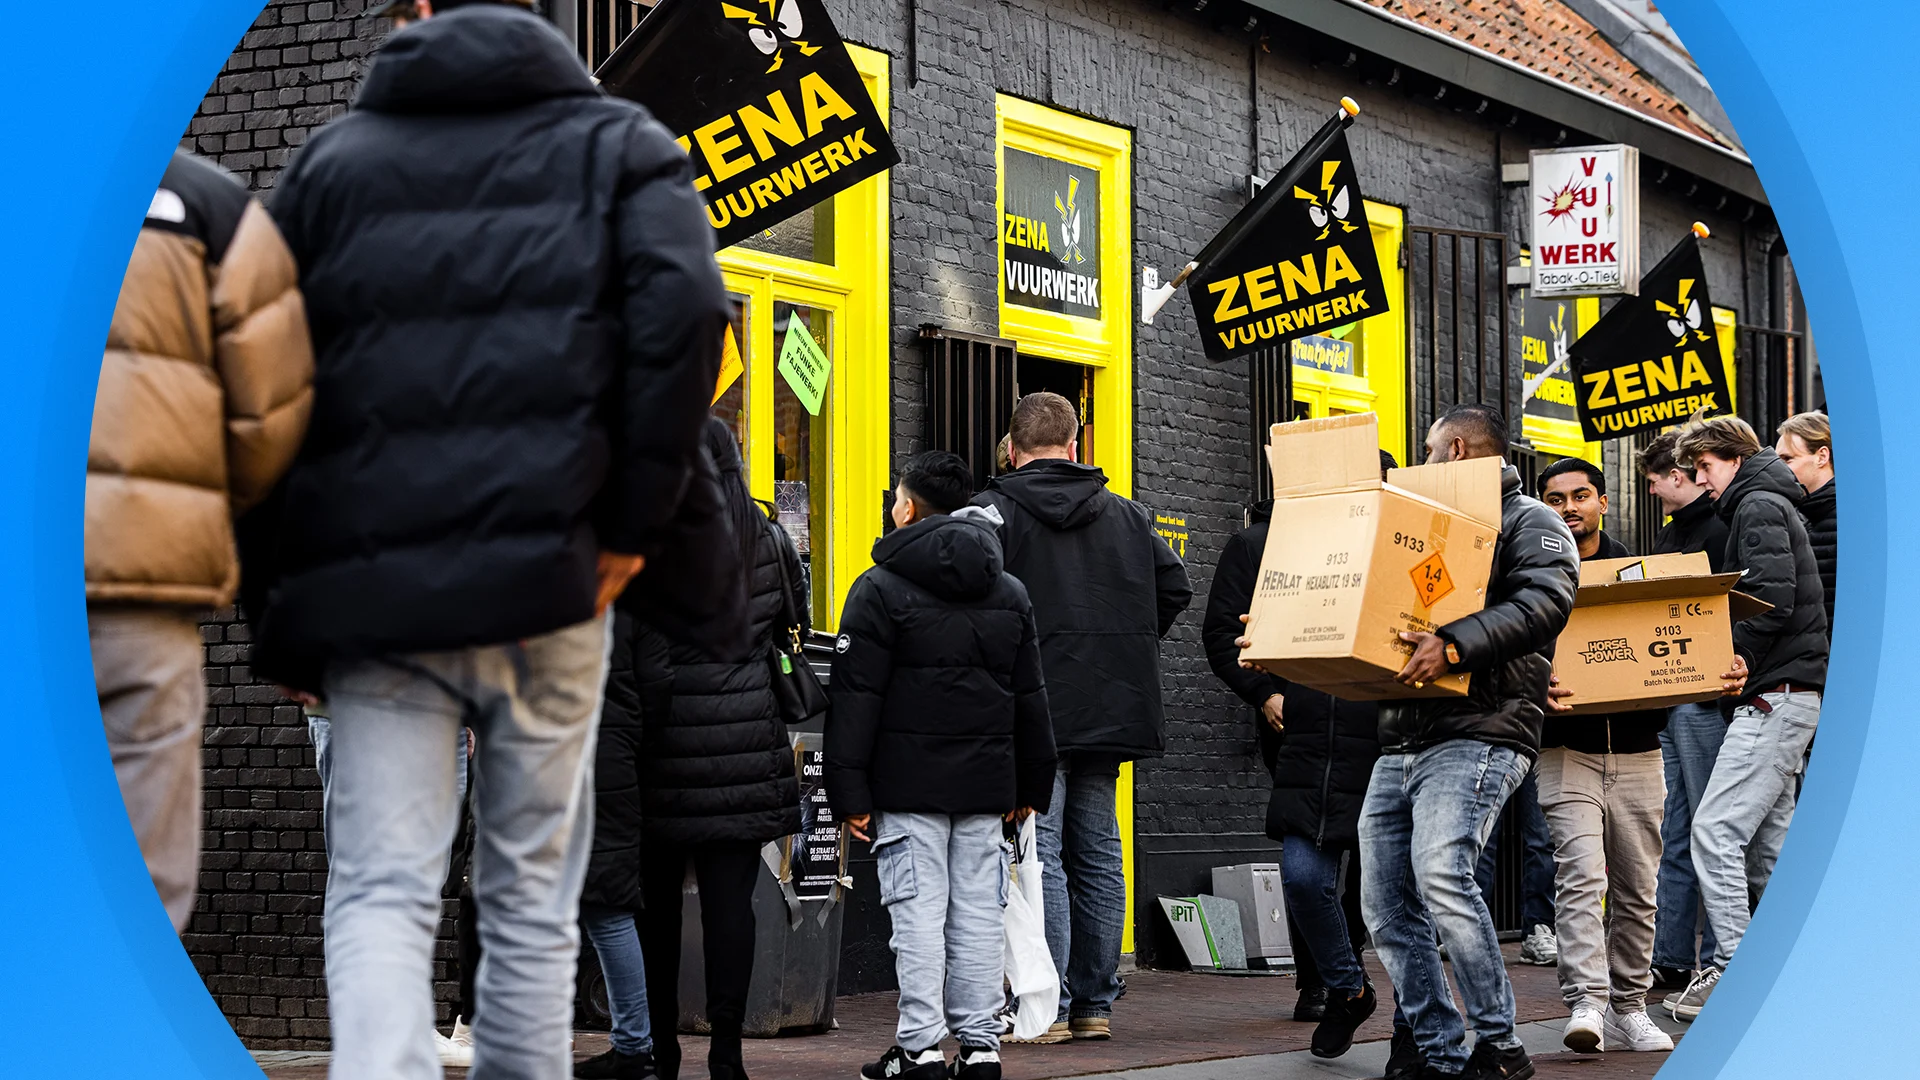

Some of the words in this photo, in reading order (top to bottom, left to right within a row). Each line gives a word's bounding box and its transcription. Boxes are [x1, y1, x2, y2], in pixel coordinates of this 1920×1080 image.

[704, 127, 877, 229] UURWERK
[1005, 214, 1050, 252] ZENA
[1540, 242, 1617, 265] WERK
[1005, 259, 1099, 308] VUURWERK
[1208, 245, 1362, 324] ZENA
[1218, 289, 1370, 350] VUURWERK
[1522, 335, 1548, 366] ZENA
[796, 346, 816, 378] FUNKE
[1582, 350, 1713, 410] ZENA
[1591, 391, 1719, 434] VUURWERK
[1394, 532, 1425, 553] 9133
[1326, 552, 1349, 566] 9133
[1261, 569, 1302, 591] HERLAT
[1305, 574, 1340, 591] HEXABLITZ
[1341, 573, 1350, 588] 19
[1351, 573, 1363, 588] SH
[1425, 564, 1442, 583] 1.4
[1426, 582, 1434, 593] G
[1399, 611, 1426, 626] ORIGINAL
[1655, 625, 1682, 637] 9103
[1587, 637, 1628, 652] HORSE
[1648, 638, 1692, 658] GT
[1577, 648, 1639, 664] POWER
[1650, 669, 1668, 677] MADE
[1676, 666, 1697, 675] CHINA
[1643, 679, 1663, 687] Batch
